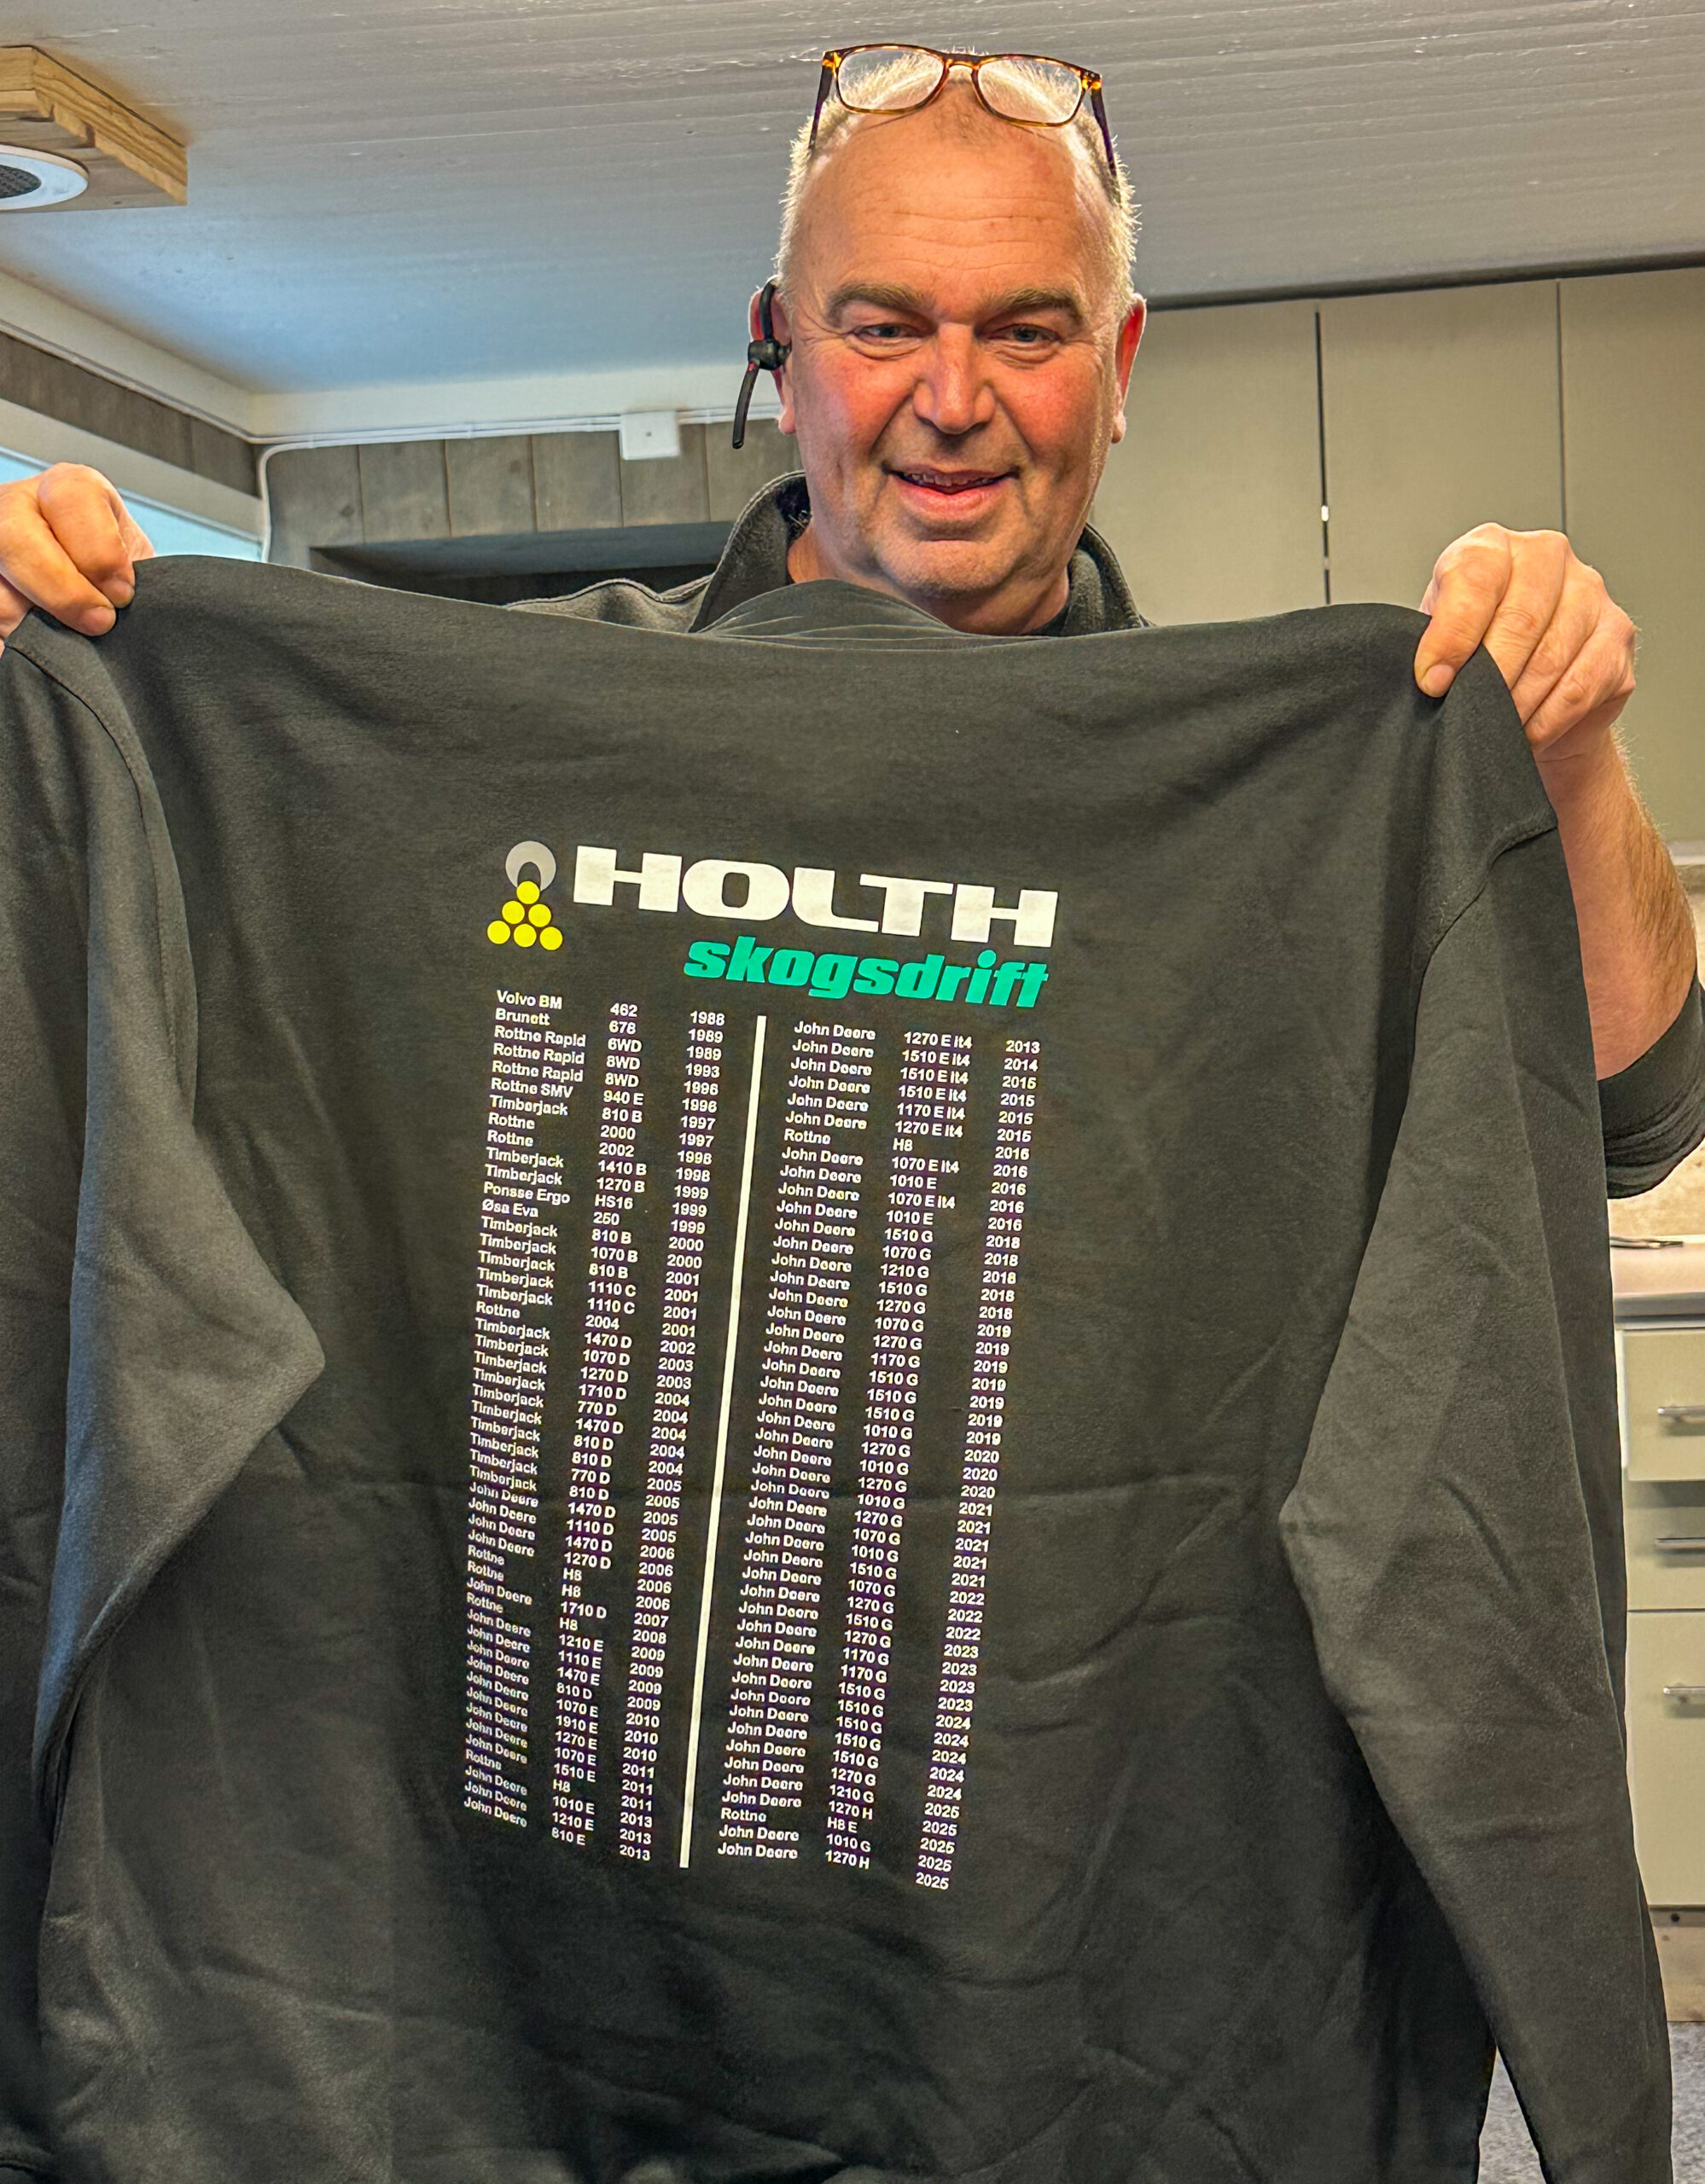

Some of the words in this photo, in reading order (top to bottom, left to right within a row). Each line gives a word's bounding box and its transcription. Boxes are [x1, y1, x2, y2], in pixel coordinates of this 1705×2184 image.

[573, 845, 1058, 947] HOLTH
[684, 935, 1049, 1008] skogsdrift
[495, 1008, 551, 1026] Brunett
[609, 1020, 637, 1036] 678
[688, 1028, 724, 1044] 1989
[497, 990, 537, 1008] Volvo
[538, 995, 563, 1010] BM
[610, 1002, 638, 1018] 462
[690, 1011, 725, 1027] 1988
[494, 1025, 543, 1043] Rottne
[544, 1031, 587, 1049] Rapid
[608, 1037, 643, 1054] 6WD
[686, 1045, 723, 1061] 1989
[792, 1039, 829, 1054] John
[831, 1043, 875, 1059] Deere
[902, 1049, 938, 1065] 1510
[939, 1052, 951, 1066] E
[1004, 1058, 1039, 1072] 2014
[794, 1021, 830, 1037] John
[833, 1025, 876, 1041] Deere
[904, 1031, 940, 1047] 1270
[940, 1034, 952, 1048] E
[1005, 1040, 1041, 1054] 2013
[489, 1095, 568, 1117] Timberjack
[602, 1107, 630, 1123] 810
[631, 1110, 643, 1124] B
[680, 1115, 717, 1131] 1997
[491, 1077, 538, 1095] Rottne
[540, 1083, 574, 1099] SMV
[603, 1090, 631, 1105] 940
[633, 1093, 645, 1107] E
[682, 1098, 718, 1113] 1996
[487, 1130, 534, 1147] Rottne
[599, 1142, 635, 1159] 2002
[677, 1150, 713, 1165] 1998
[784, 1128, 832, 1146] Rottne
[893, 1137, 914, 1153] H8
[995, 1146, 1030, 1161] 2016
[486, 1147, 565, 1169] Timberjack
[598, 1160, 633, 1176] 1410
[636, 1163, 648, 1176] B
[676, 1167, 711, 1183] 1998
[484, 1181, 534, 1200] Ponsse
[537, 1188, 571, 1206] Ergo
[595, 1194, 634, 1211] HS16
[672, 1202, 708, 1218] 1999
[777, 1199, 812, 1216] John
[815, 1203, 858, 1220] Deere
[886, 1210, 921, 1225] 1010
[922, 1212, 934, 1226] E
[988, 1217, 1023, 1232] 2016
[513, 1203, 539, 1218] Eva
[593, 1211, 620, 1226] 250
[671, 1219, 706, 1235] 1999
[480, 1233, 557, 1256] Timberjack
[591, 1246, 626, 1262] 1070
[627, 1250, 638, 1263] B
[666, 1254, 703, 1269] 2000
[771, 1252, 806, 1269] John
[810, 1257, 852, 1273] Deere
[881, 1263, 916, 1278] 1210
[917, 1266, 930, 1279] G
[982, 1270, 1017, 1285] 2018
[476, 1301, 521, 1320] Rottne
[585, 1315, 620, 1331] 2004
[661, 1323, 696, 1339] 2001
[764, 1340, 799, 1356] John
[800, 1345, 843, 1362] Deere
[870, 1352, 906, 1368] 1170
[908, 1356, 921, 1369] G
[974, 1360, 1009, 1374] 2019
[473, 1368, 546, 1391] Timberjack
[579, 1384, 614, 1399] 1710
[615, 1387, 627, 1401] D
[655, 1392, 690, 1408] 2004
[471, 1416, 541, 1443] Timberjack
[573, 1434, 600, 1450] 810
[602, 1438, 614, 1451] D
[650, 1443, 686, 1460] 2004
[755, 1427, 789, 1444] John
[792, 1432, 835, 1450] Deere
[861, 1442, 897, 1457] 1270
[899, 1444, 911, 1458] G
[964, 1449, 1000, 1464] 2020
[469, 1482, 499, 1499] John
[501, 1490, 539, 1508] Deere
[568, 1502, 602, 1518] 1470
[604, 1506, 617, 1519] D
[643, 1511, 679, 1527] 2005
[747, 1513, 783, 1529] John
[785, 1518, 826, 1535] Deere
[852, 1528, 887, 1544] 1070
[888, 1532, 901, 1546] G
[955, 1537, 990, 1554] 2021
[468, 1530, 497, 1548] John
[498, 1537, 535, 1558] Deere
[564, 1552, 598, 1568] 1270
[600, 1556, 612, 1570] D
[638, 1562, 674, 1577] 2006
[467, 1577, 495, 1595] John
[497, 1585, 532, 1606] Deere
[561, 1601, 594, 1618] 1710
[596, 1606, 608, 1619] D
[634, 1612, 670, 1629] 2007
[738, 1601, 774, 1617] John
[777, 1604, 819, 1621] Deere
[846, 1613, 880, 1629] 1510
[882, 1618, 893, 1631] G
[946, 1626, 981, 1641] 2022
[467, 1640, 493, 1658] John
[495, 1649, 531, 1670] Deere
[557, 1667, 589, 1684] 1470
[591, 1674, 601, 1687] E
[628, 1680, 663, 1695] 2009
[730, 1688, 765, 1703] John
[769, 1692, 812, 1707] Deere
[838, 1699, 870, 1716] 1510
[872, 1705, 884, 1718] G
[935, 1714, 972, 1731] 2024
[466, 1702, 493, 1721] John
[495, 1712, 528, 1733] Deere
[556, 1731, 586, 1748] 1270
[588, 1738, 598, 1751] E
[623, 1747, 658, 1763] 2010
[466, 1749, 503, 1771] Rottne
[553, 1779, 571, 1793] H8
[621, 1795, 652, 1812] 2011
[724, 1757, 759, 1771] John
[762, 1760, 805, 1774] Deere
[831, 1767, 863, 1785] 1270
[864, 1774, 876, 1787] G
[927, 1785, 963, 1802] 2024
[464, 1797, 492, 1815] John
[494, 1806, 527, 1828] Deere
[552, 1827, 574, 1844] 810
[577, 1834, 586, 1846] E
[620, 1844, 651, 1862] 2013
[721, 1808, 767, 1823] Rottne
[827, 1816, 847, 1832] H8
[848, 1821, 858, 1834] E
[920, 1838, 956, 1855] 2025
[718, 1842, 754, 1857] John
[755, 1844, 799, 1860] Deere
[825, 1850, 858, 1867] 1270
[858, 1856, 870, 1870] H
[916, 1872, 950, 1891] 2025
